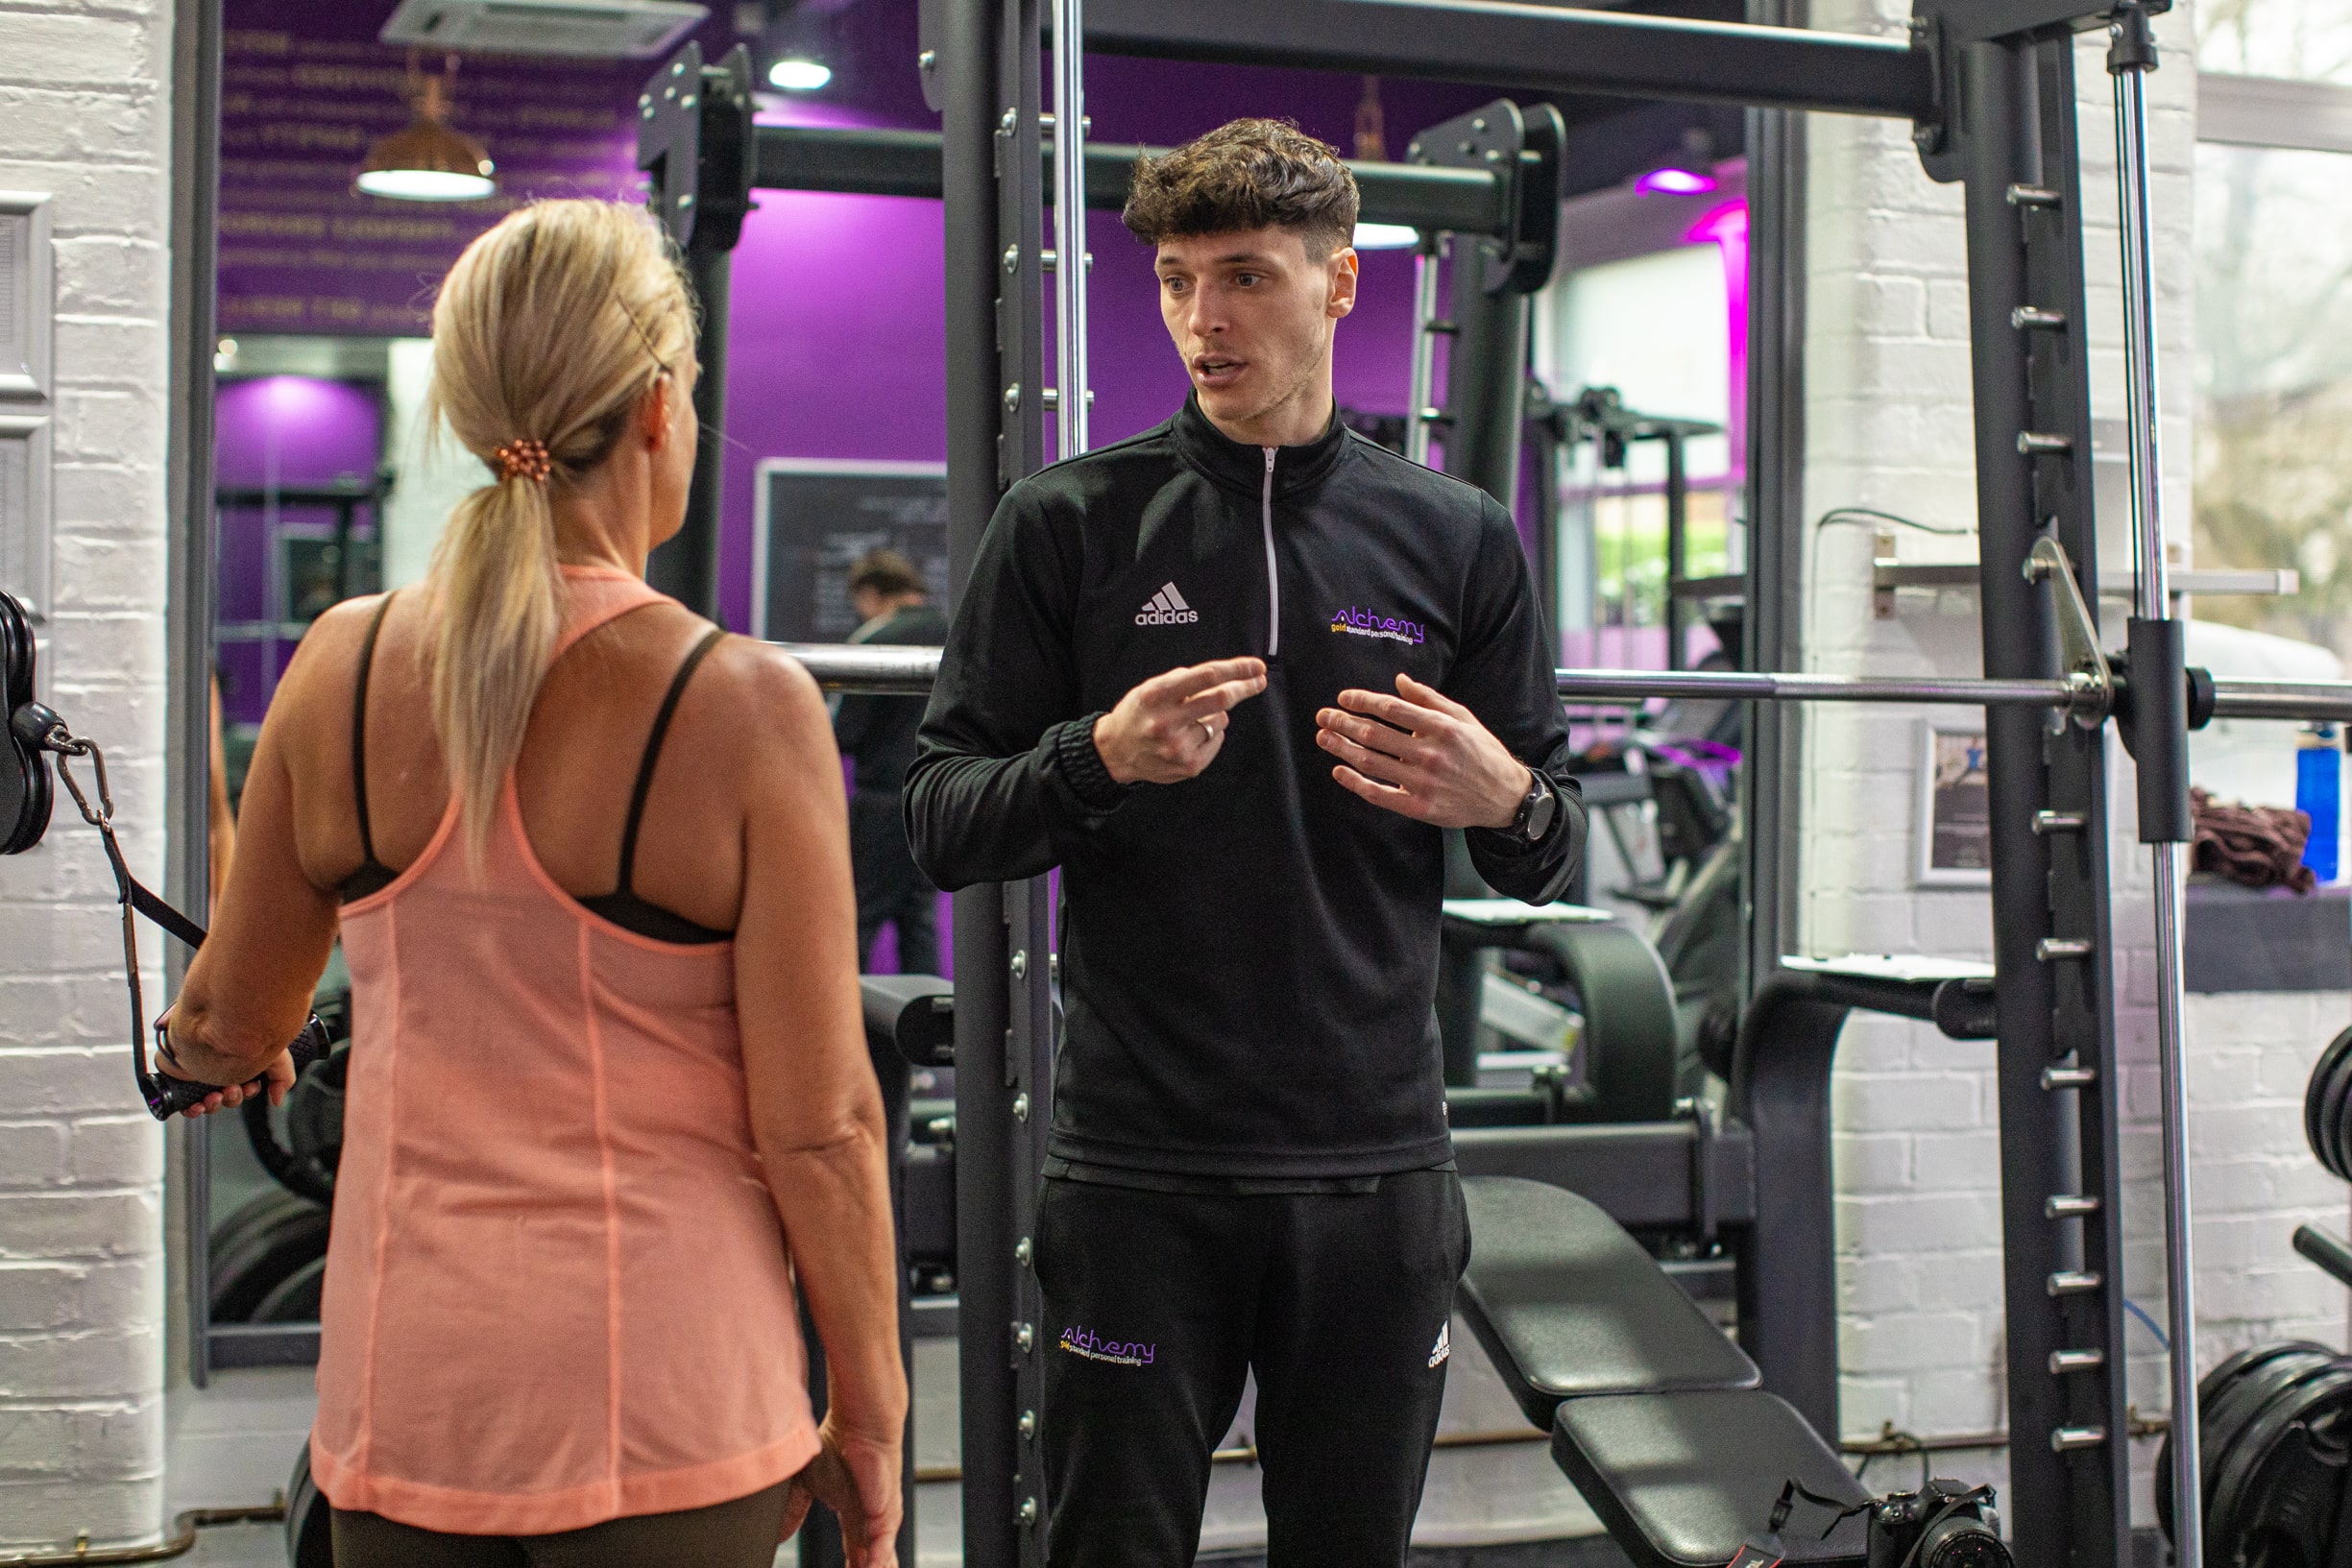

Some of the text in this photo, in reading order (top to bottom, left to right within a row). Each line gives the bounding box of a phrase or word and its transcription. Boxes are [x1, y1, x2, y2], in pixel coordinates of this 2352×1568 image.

[1134, 609, 1200, 626] adidas
[1330, 605, 1425, 644] Alchemy
[1330, 622, 1346, 633] gold
[1060, 1324, 1156, 1363] Alchemy
[1090, 1351, 1117, 1363] personal
[1116, 1356, 1142, 1367] training
